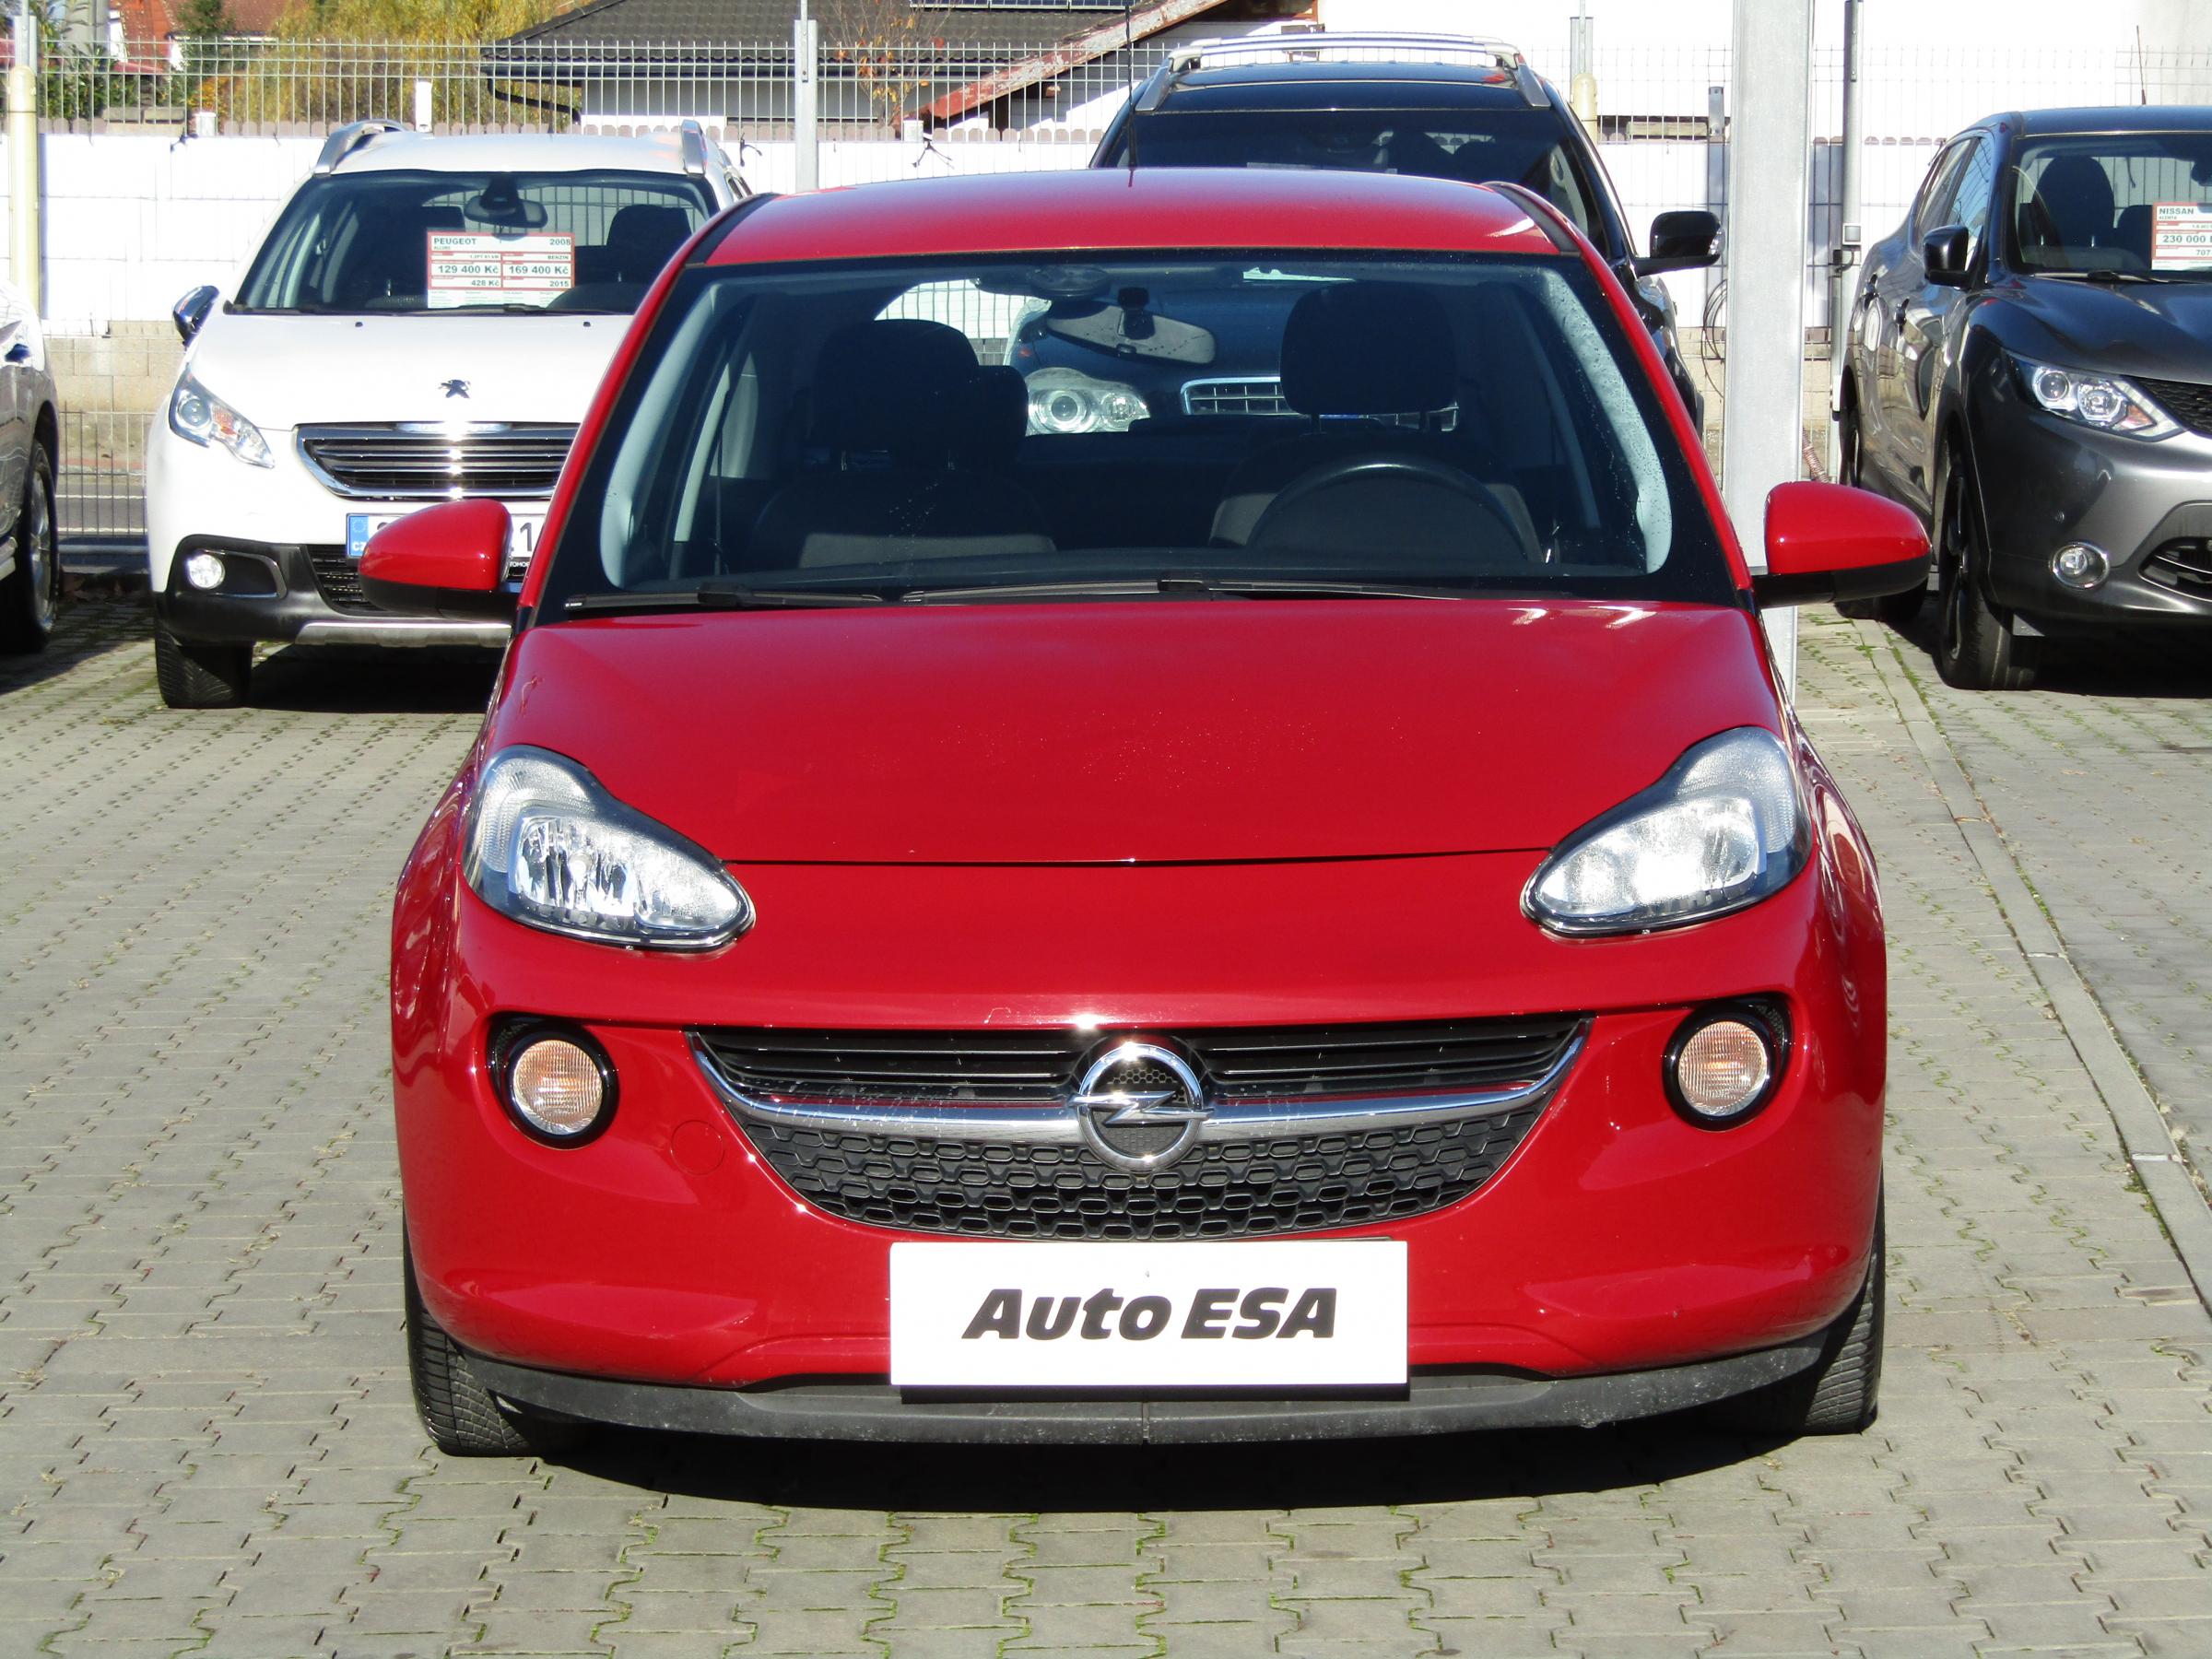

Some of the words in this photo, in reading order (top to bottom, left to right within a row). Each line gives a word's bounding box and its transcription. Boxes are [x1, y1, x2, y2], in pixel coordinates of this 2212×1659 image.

[549, 238, 571, 246] 2008
[2162, 235, 2183, 243] 230
[2185, 235, 2206, 243] 000
[438, 265, 458, 274] 129
[461, 265, 481, 274] 400
[484, 265, 500, 274] Kč
[509, 265, 528, 275] 169
[531, 265, 551, 275] 400
[554, 265, 569, 275] Kč
[961, 1288, 1172, 1341] Auto
[1181, 1287, 1337, 1340] ESA
